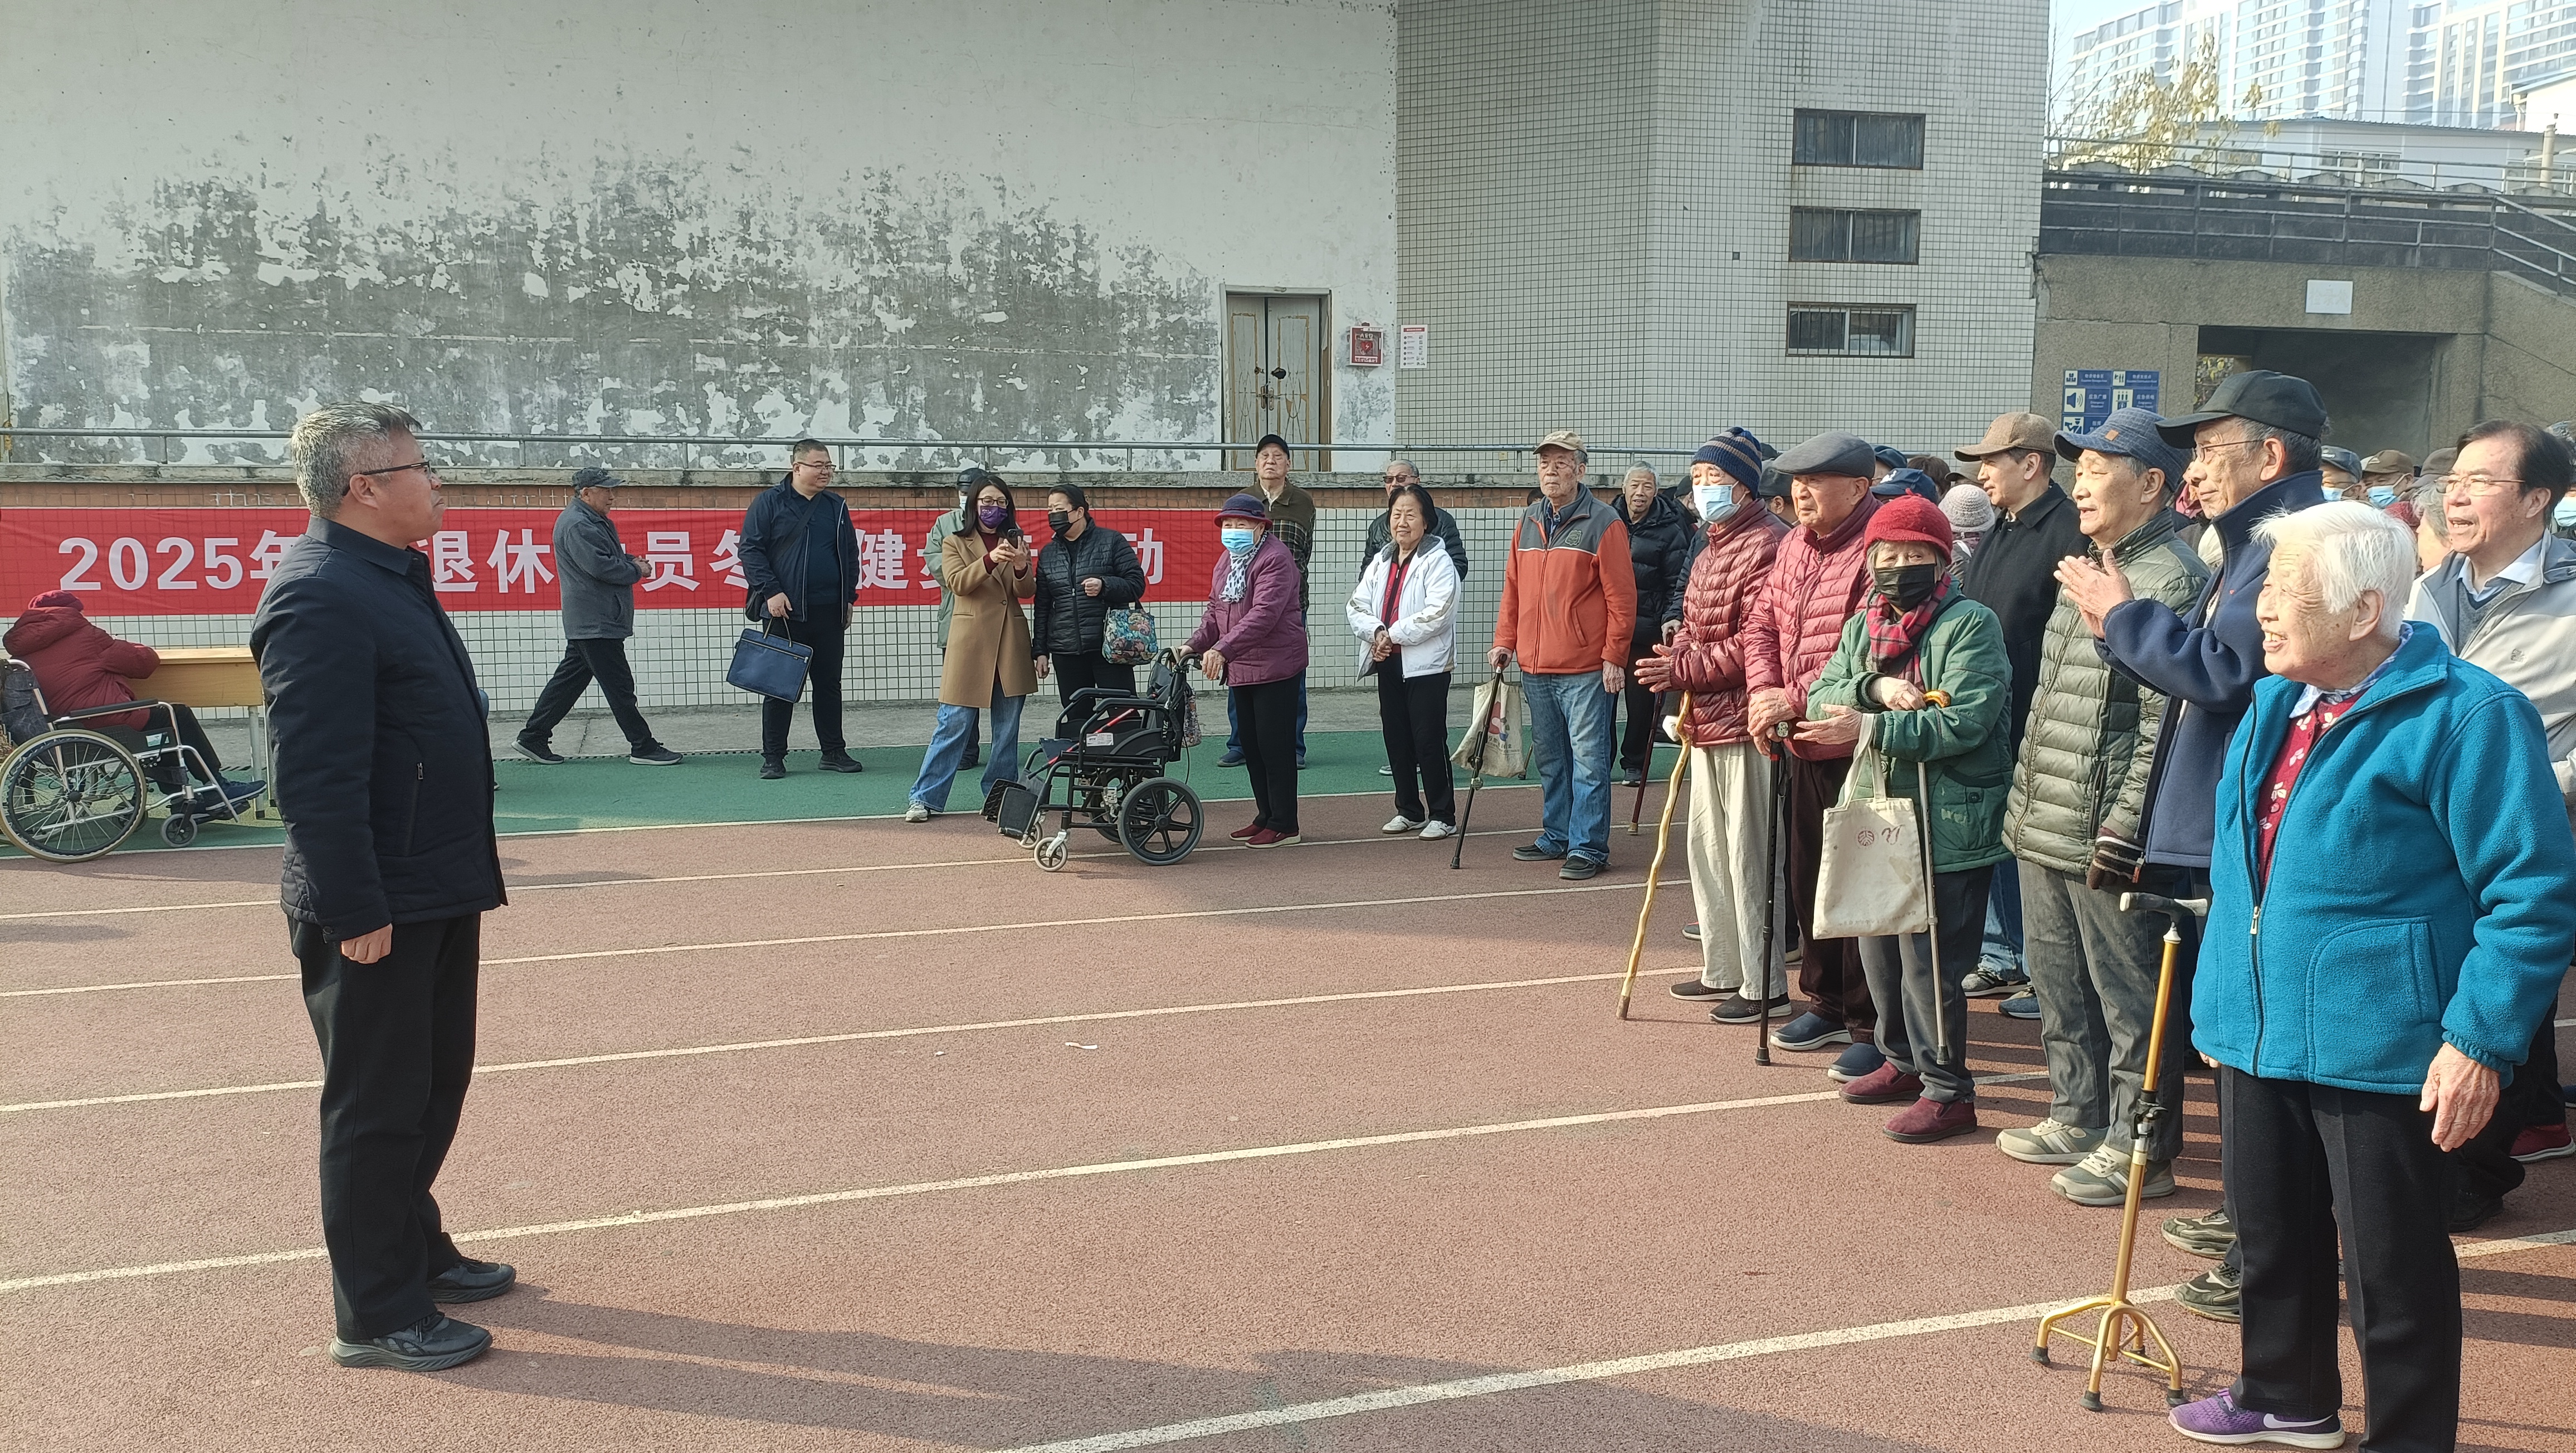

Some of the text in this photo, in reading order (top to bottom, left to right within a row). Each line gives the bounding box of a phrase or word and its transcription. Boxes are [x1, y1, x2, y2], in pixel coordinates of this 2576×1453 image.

[57, 528, 1163, 594] 2025年退休员冬健动
